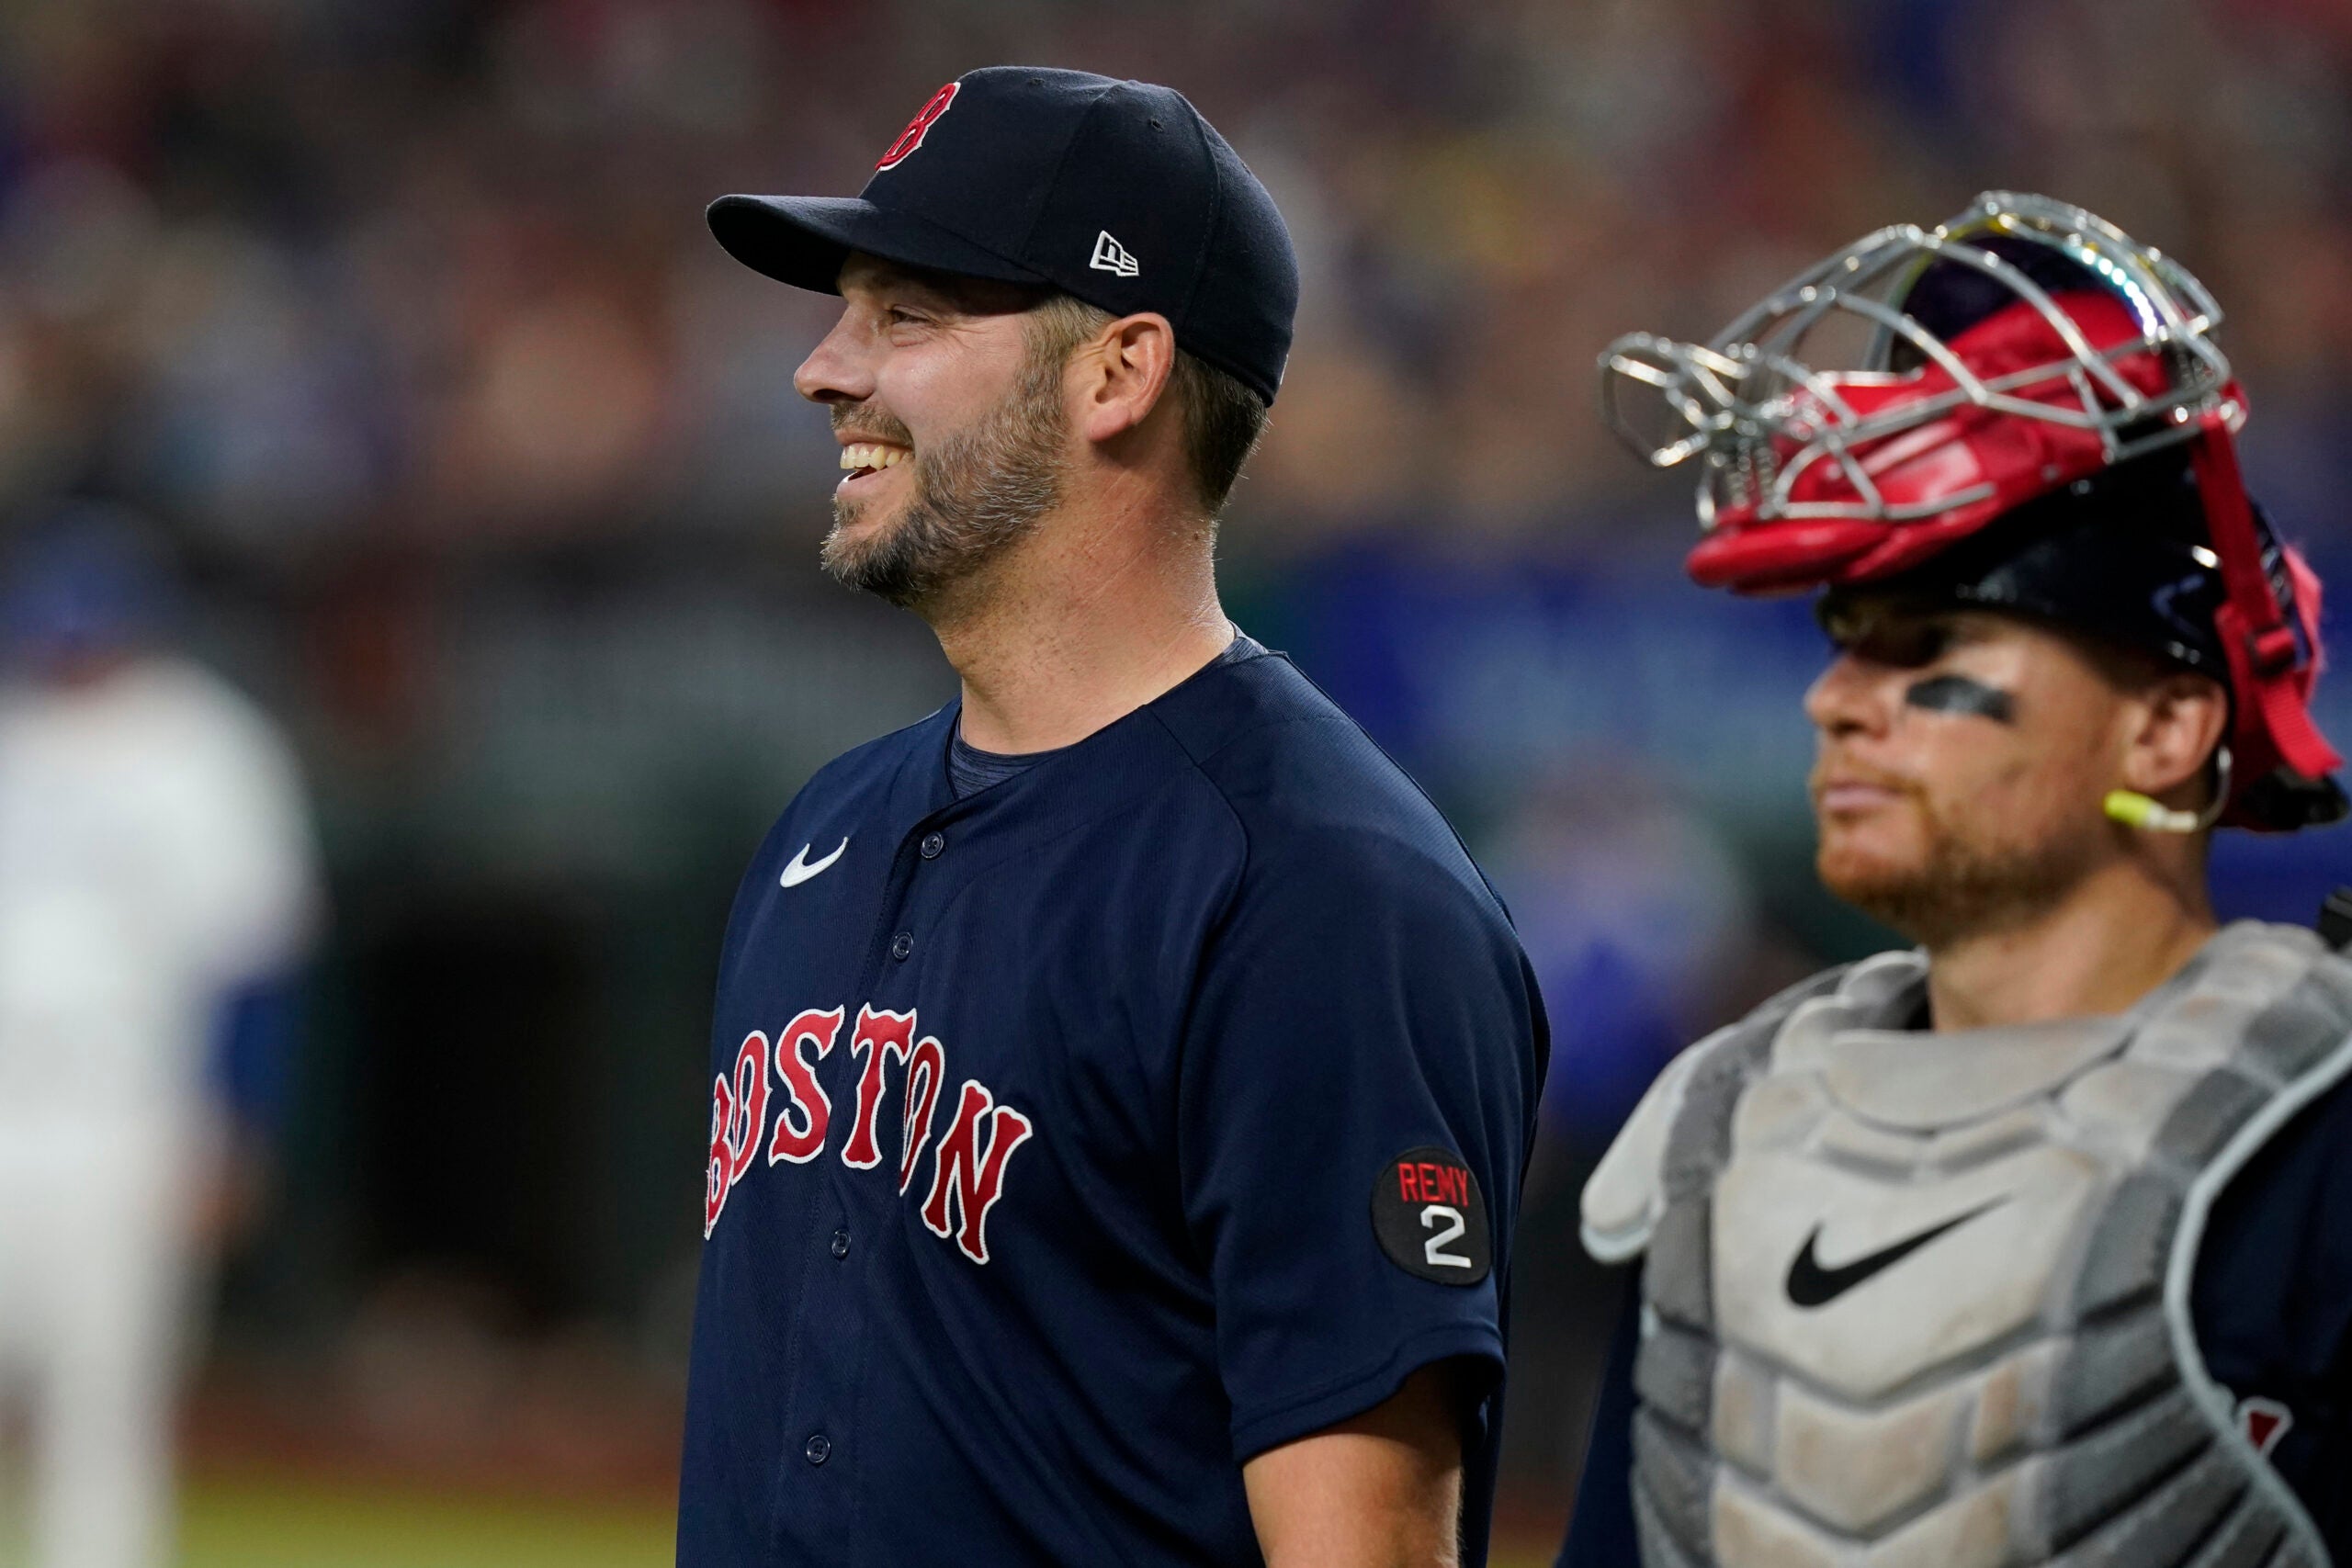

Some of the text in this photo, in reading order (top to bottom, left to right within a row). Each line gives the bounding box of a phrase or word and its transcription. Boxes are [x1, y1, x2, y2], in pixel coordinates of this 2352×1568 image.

[875, 82, 961, 171] B
[705, 1002, 1032, 1264] BOSTON
[1397, 1163, 1469, 1207] REMY
[1420, 1204, 1472, 1268] 2
